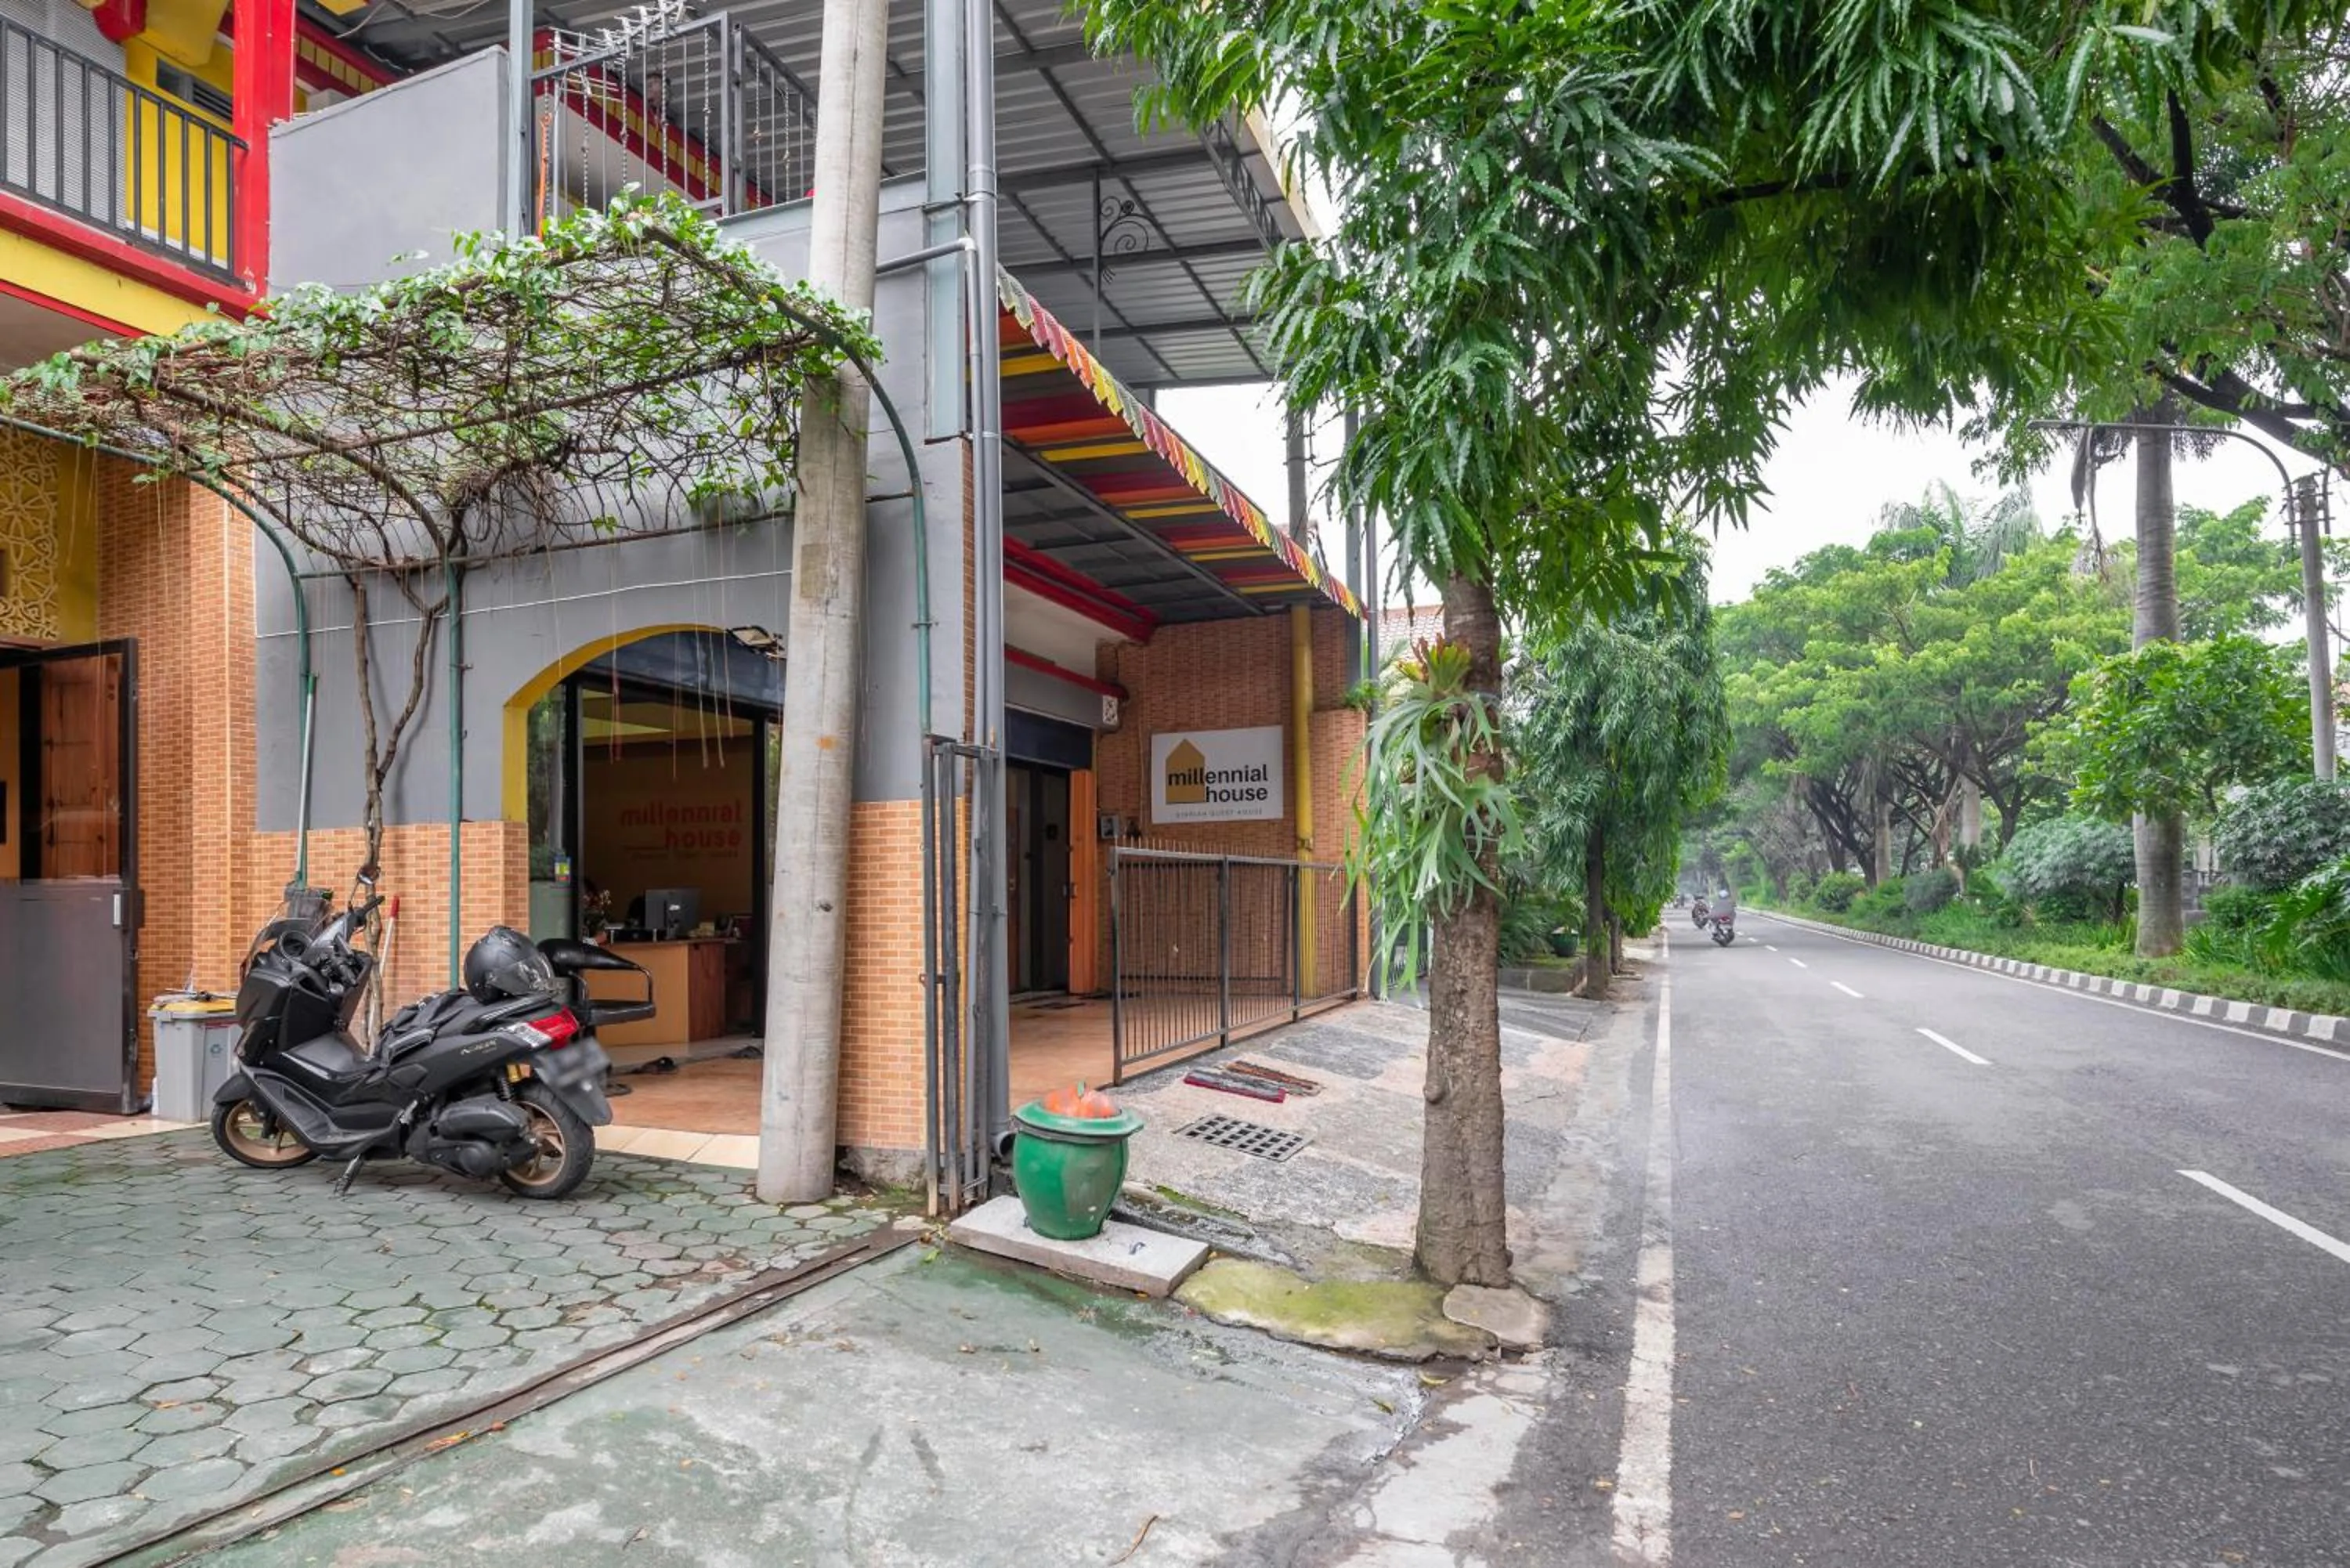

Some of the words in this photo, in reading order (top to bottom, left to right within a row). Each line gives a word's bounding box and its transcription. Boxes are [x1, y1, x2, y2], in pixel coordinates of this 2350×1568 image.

[1168, 764, 1268, 786] millennial
[1206, 786, 1268, 803] house
[664, 826, 742, 848] house
